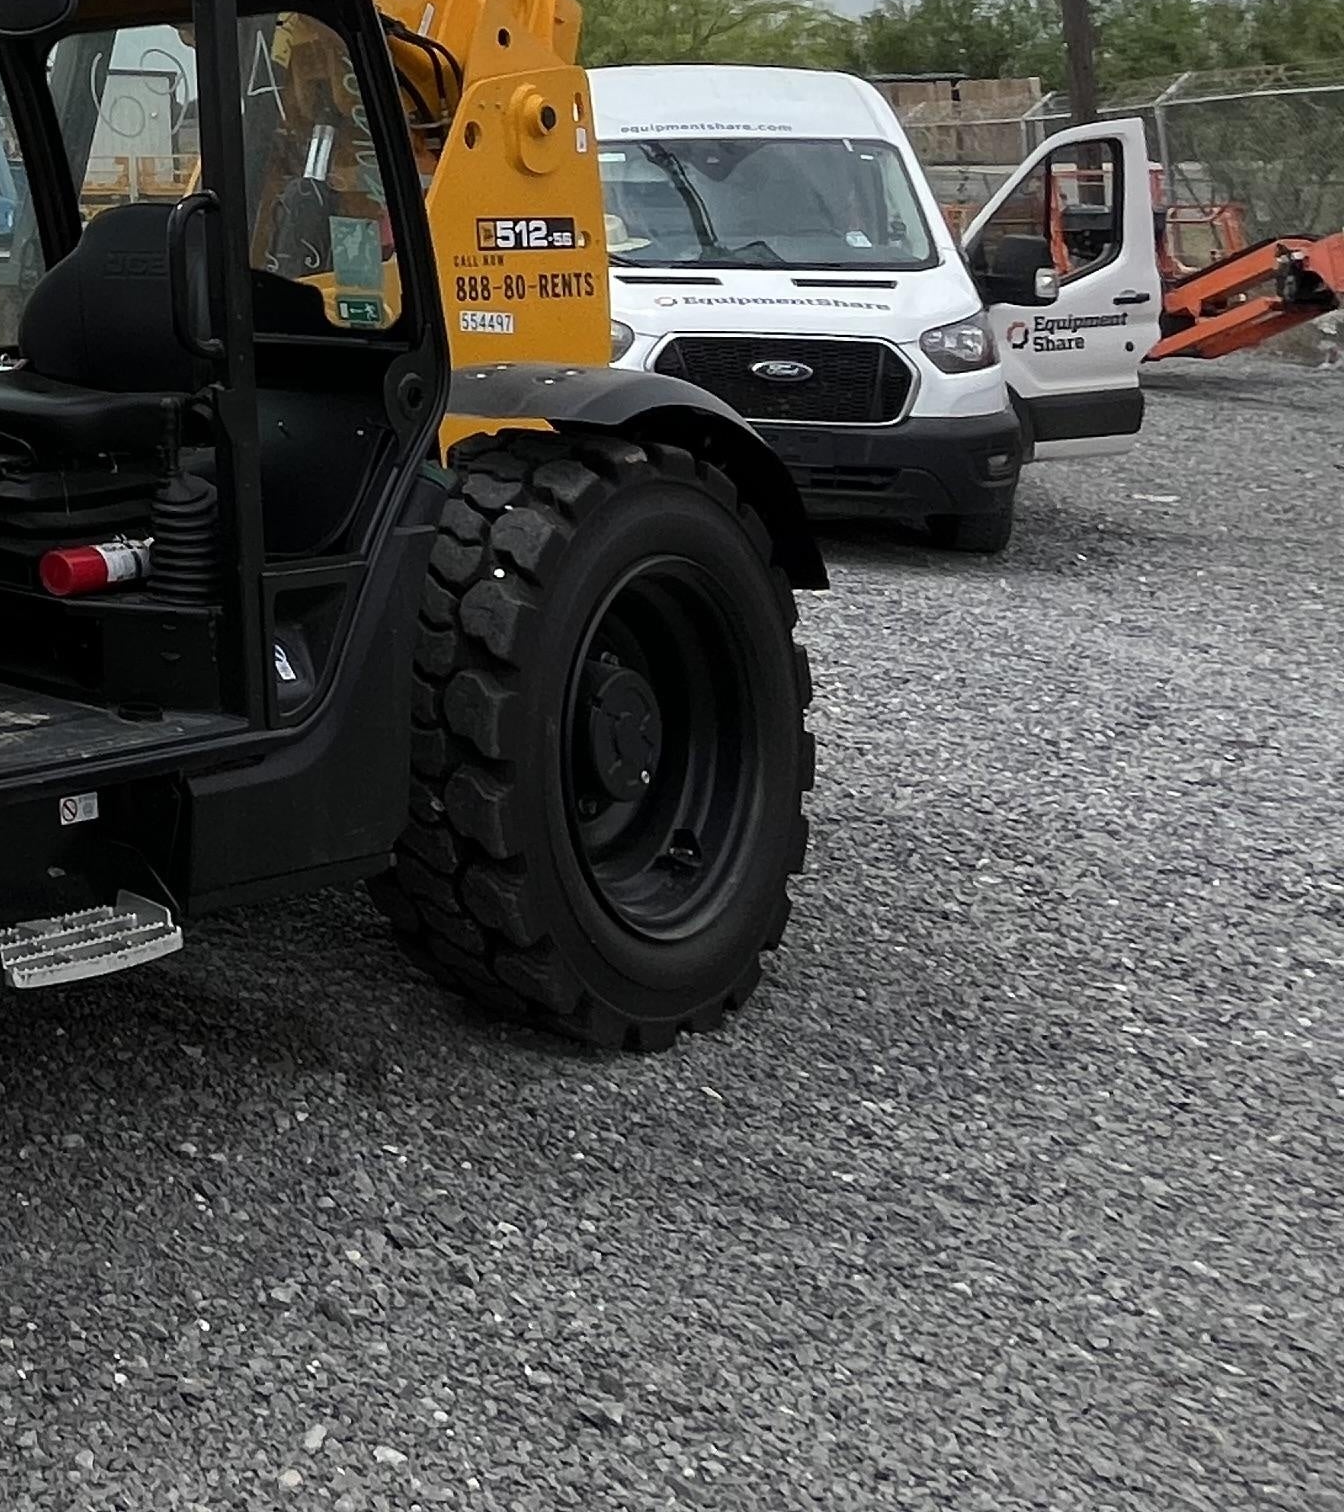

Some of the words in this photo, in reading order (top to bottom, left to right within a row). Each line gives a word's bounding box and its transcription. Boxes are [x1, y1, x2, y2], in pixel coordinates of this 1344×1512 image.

[620, 122, 793, 134] equipmentshare.com
[453, 255, 479, 267] CALL
[483, 255, 505, 267] NOW
[456, 272, 595, 302] 888-80-RENTS
[682, 296, 891, 311] EquipmentShare
[461, 312, 512, 332] 554497
[1033, 312, 1128, 335] Equipment
[1033, 336, 1085, 352] Share
